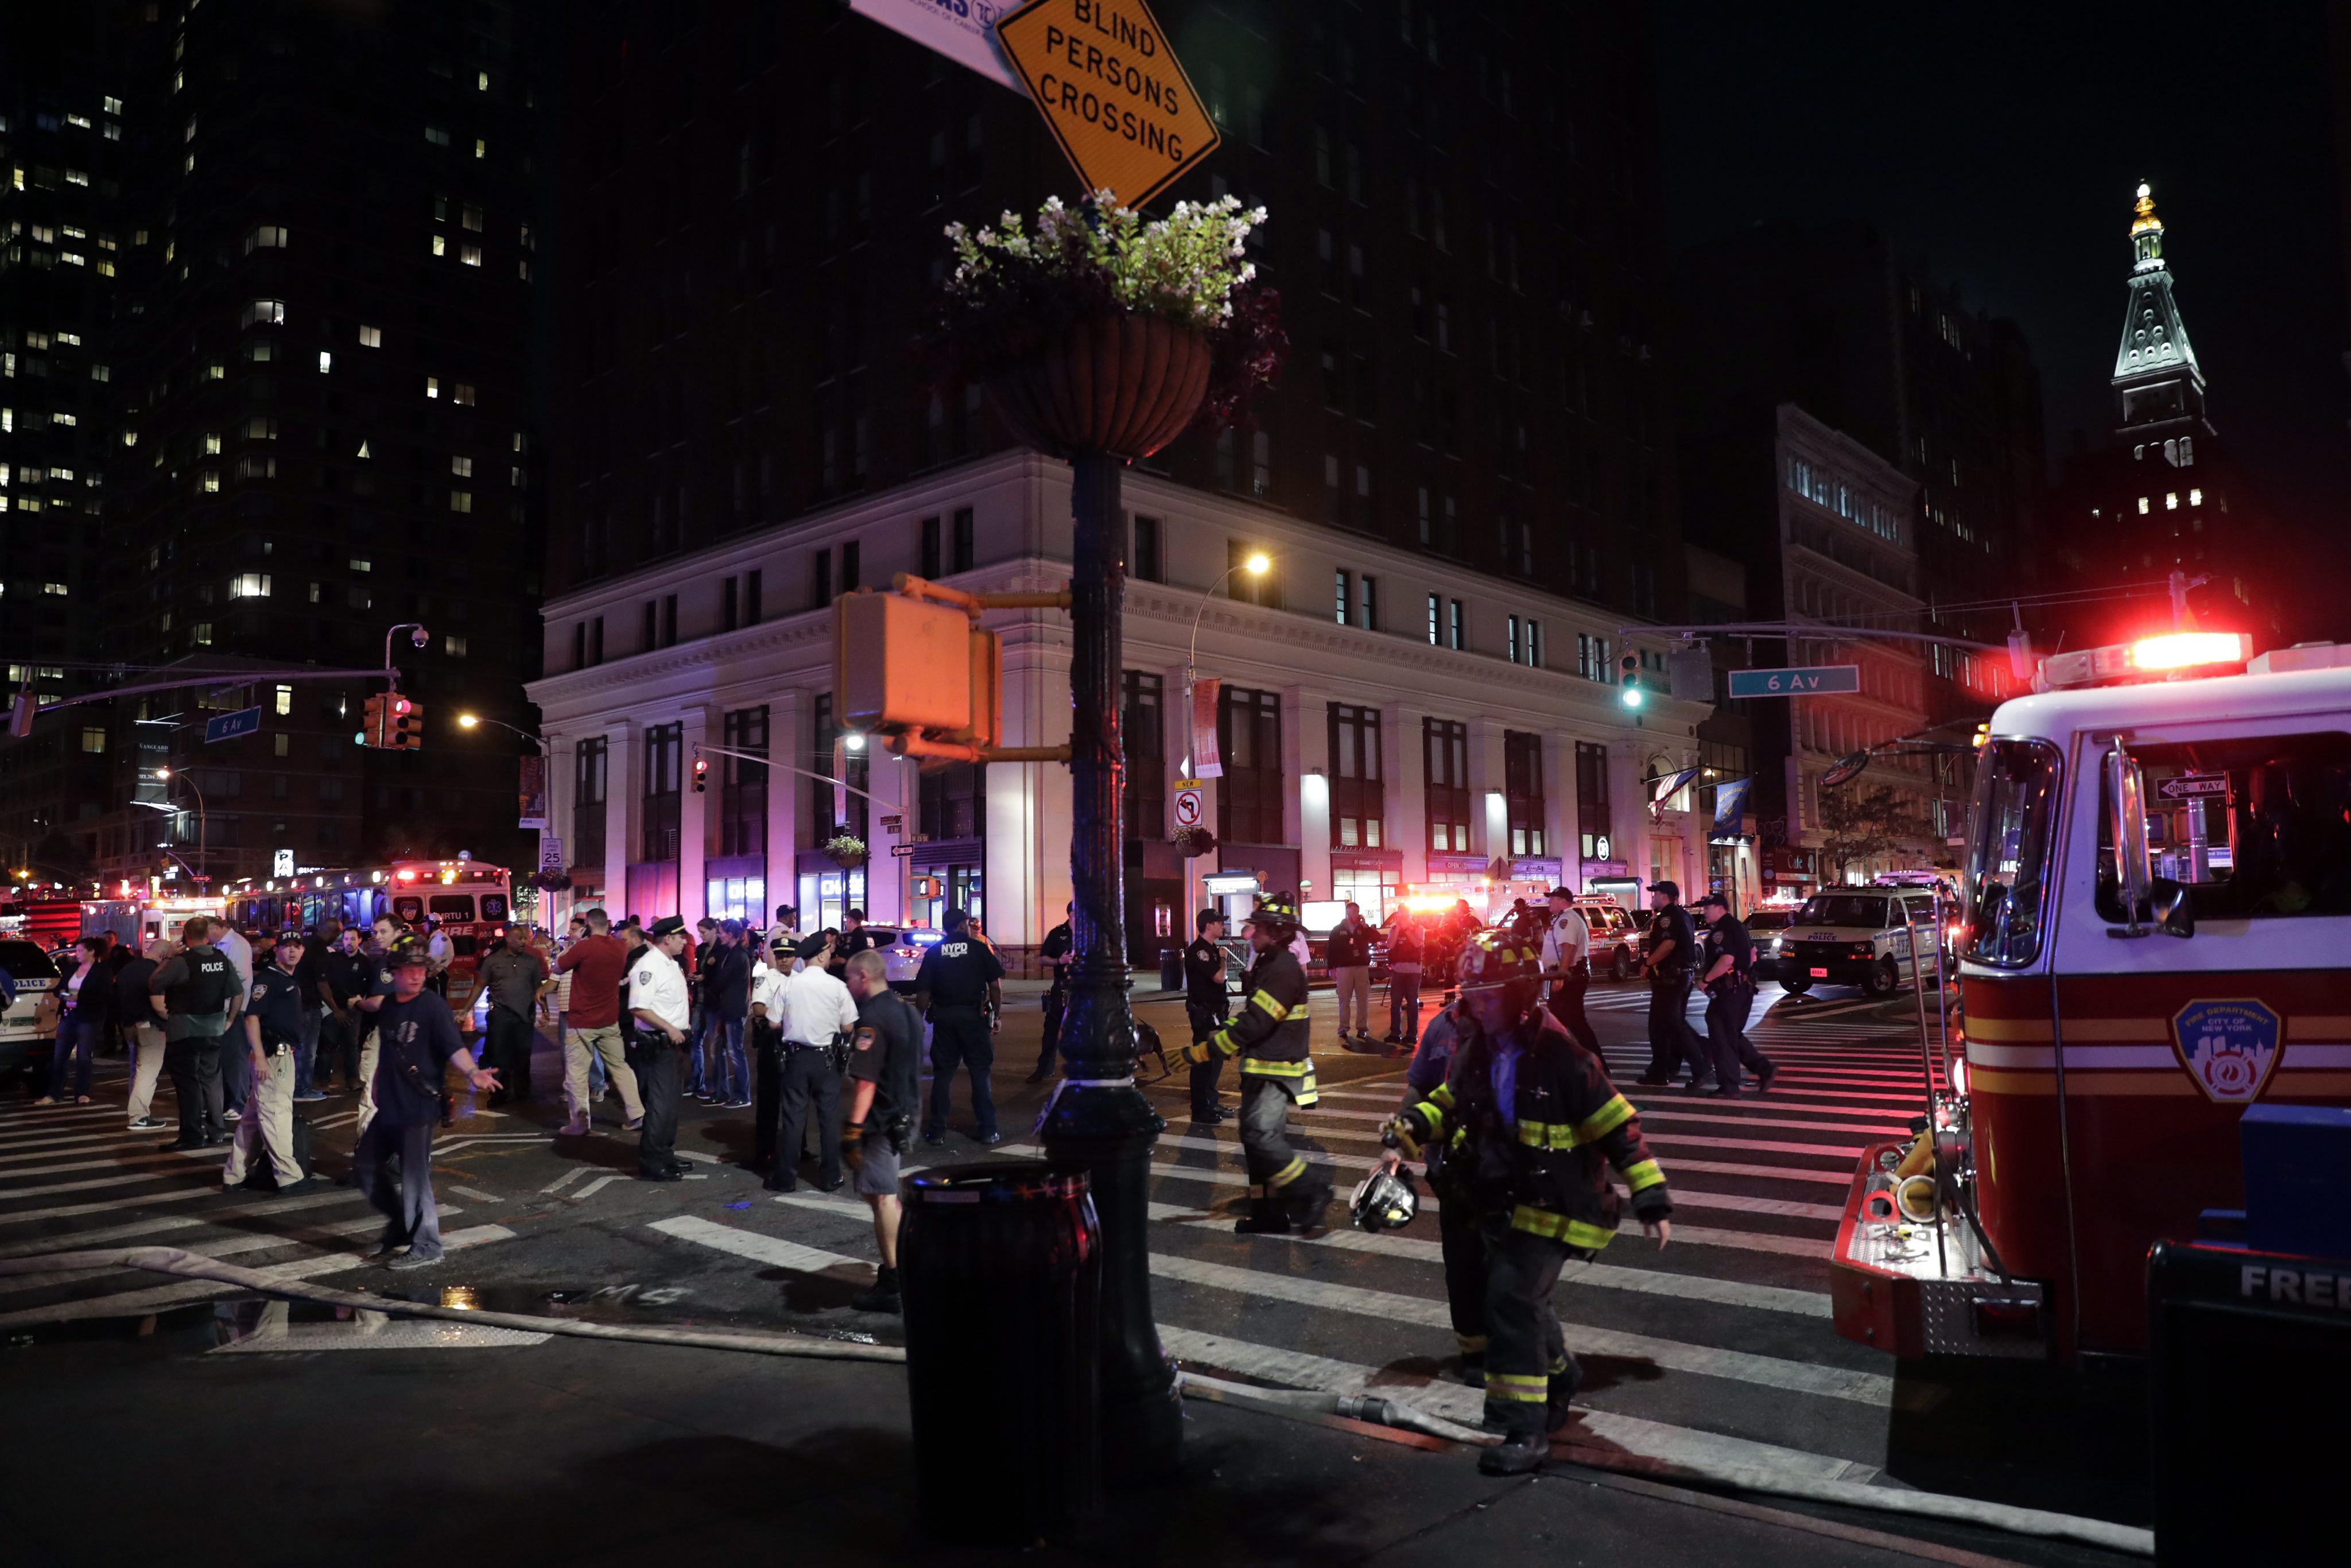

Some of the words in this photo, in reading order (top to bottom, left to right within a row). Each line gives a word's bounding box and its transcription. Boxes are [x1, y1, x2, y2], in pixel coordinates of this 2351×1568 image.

[1075, 0, 1155, 57] BLIND
[1046, 25, 1179, 115] PERSONS
[1041, 74, 1182, 162] CROSSING
[1768, 675, 1780, 690] 6
[1790, 674, 1819, 689] Av
[222, 721, 228, 733] 6
[2168, 784, 2189, 793] ONE
[2198, 782, 2221, 791] WAY
[545, 853, 560, 863] 25
[1787, 854, 1803, 869] Cafe
[941, 942, 968, 953] NYPD
[1896, 939, 1910, 954] NYP
[201, 962, 224, 972] POLICE
[13, 979, 45, 987] OLICE
[2185, 1012, 2205, 1027] FIRE
[2207, 1007, 2269, 1024] DEPARTMENT
